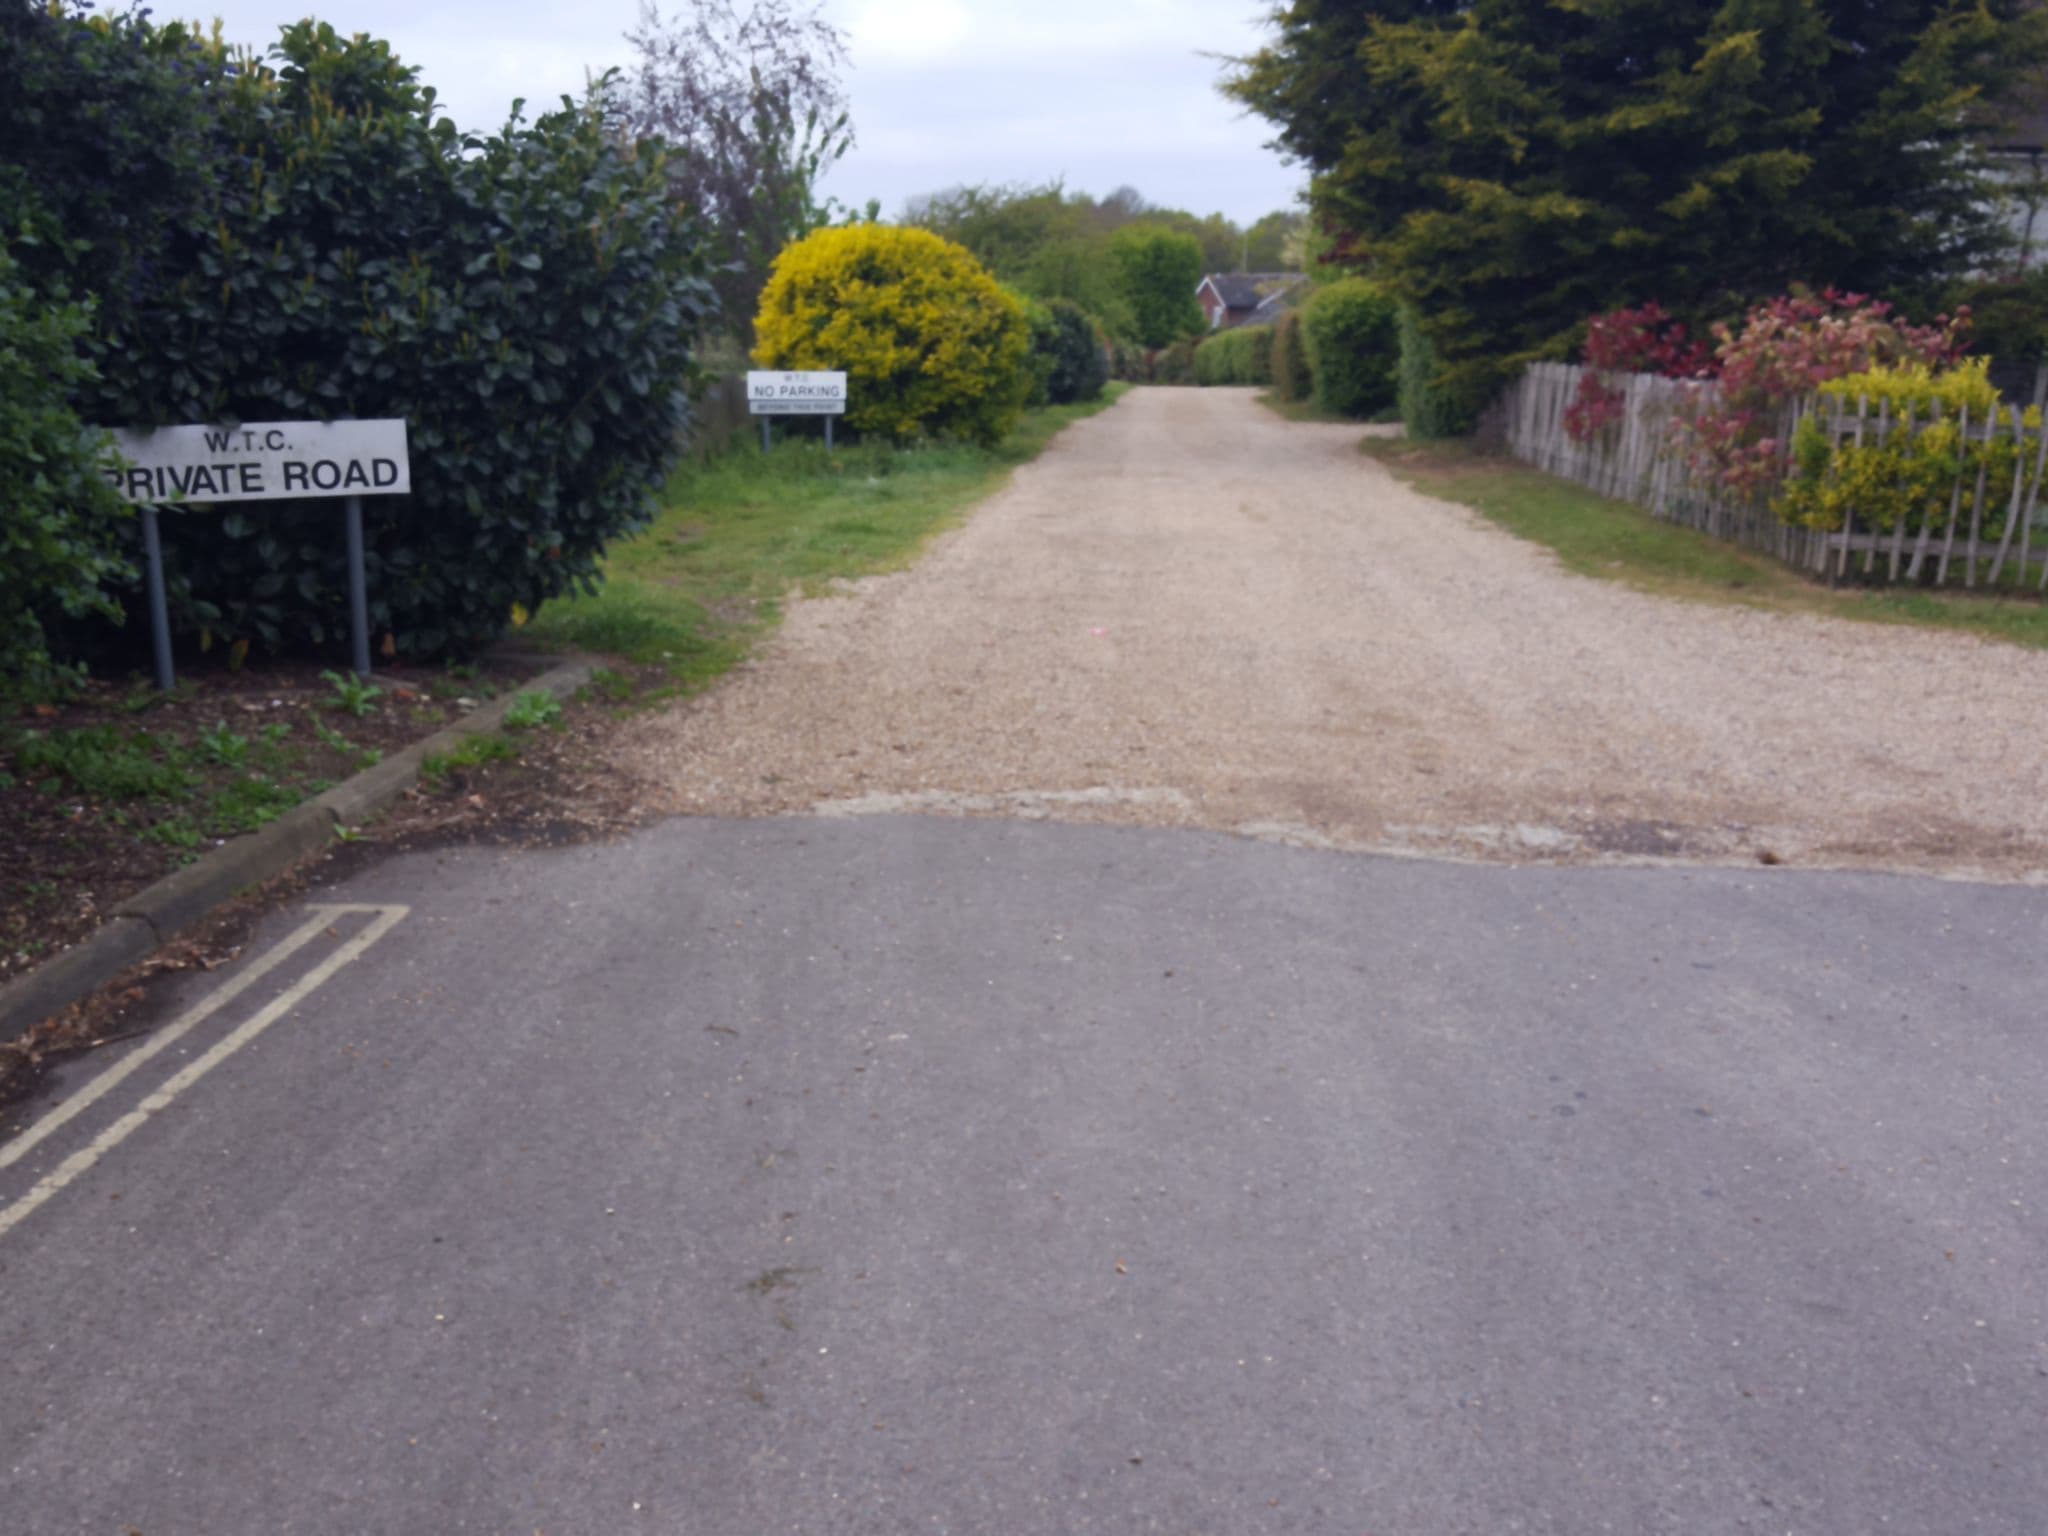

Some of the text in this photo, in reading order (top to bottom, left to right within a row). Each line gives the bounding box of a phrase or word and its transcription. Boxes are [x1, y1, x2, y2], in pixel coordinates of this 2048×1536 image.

[754, 385, 840, 397] NO PARKING
[204, 430, 293, 453] W.T.C.
[283, 458, 399, 491] ROAD
